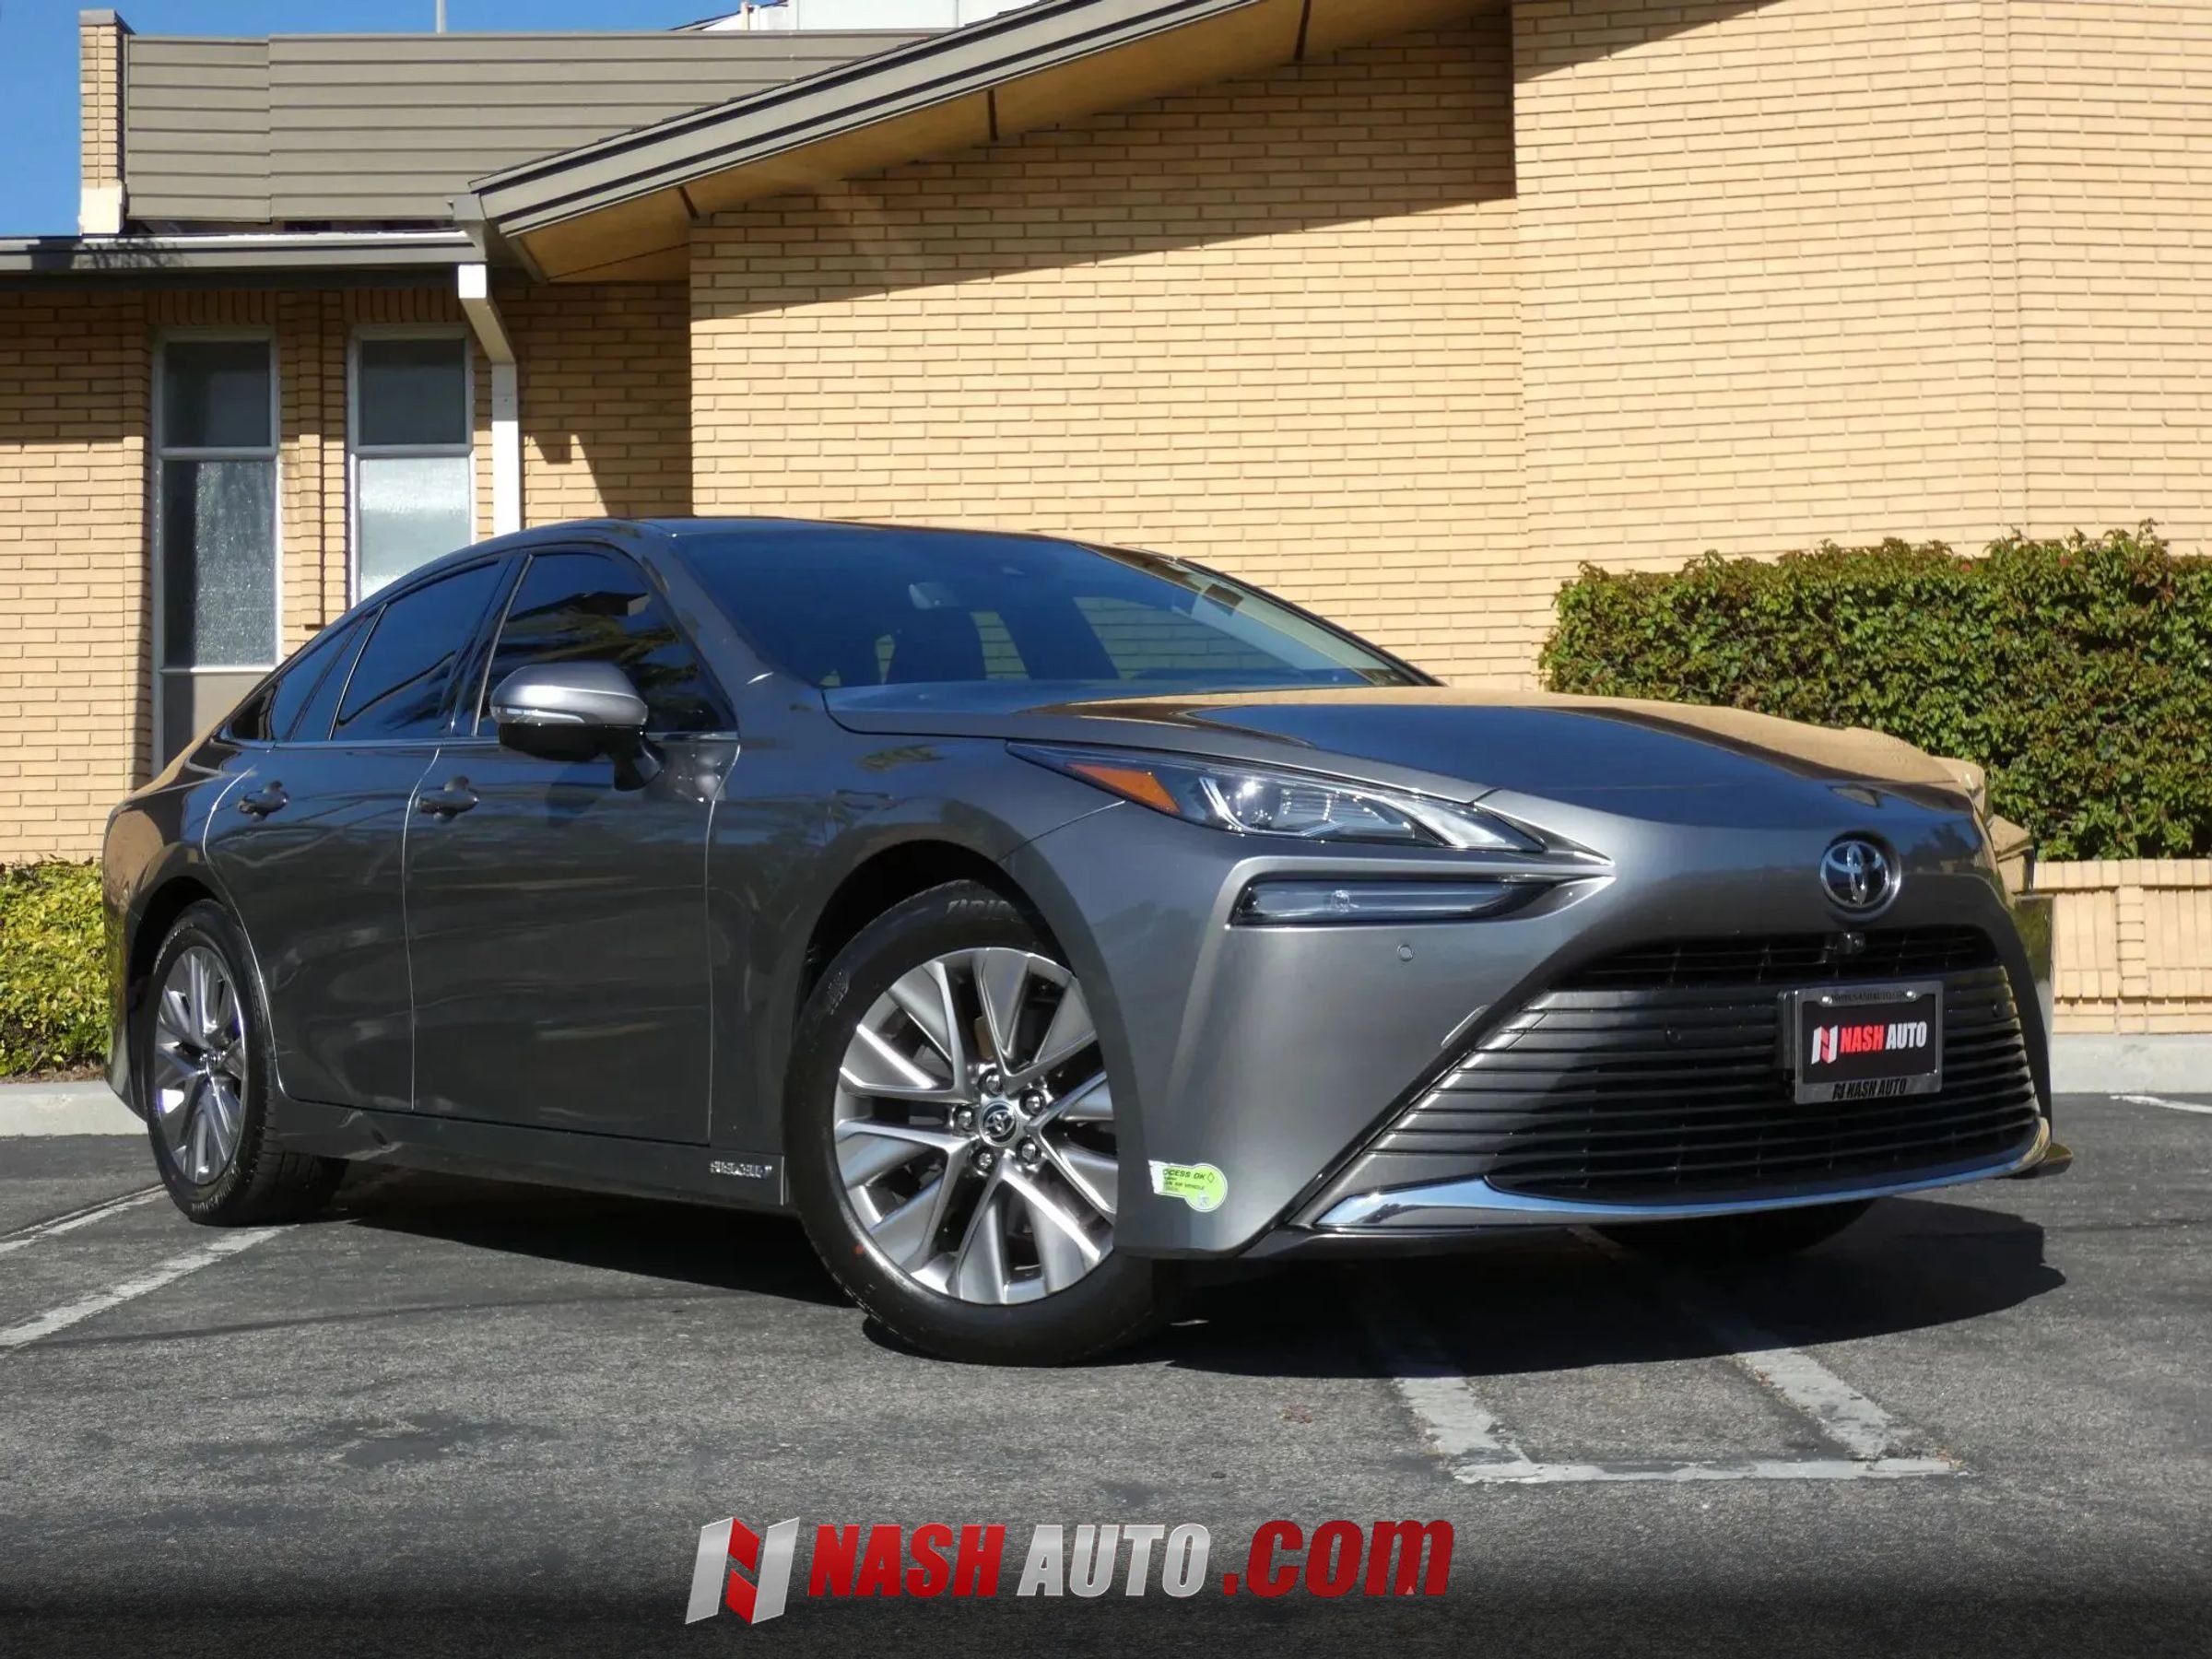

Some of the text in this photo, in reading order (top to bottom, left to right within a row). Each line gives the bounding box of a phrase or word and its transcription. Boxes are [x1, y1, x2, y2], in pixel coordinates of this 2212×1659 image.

[1840, 1025, 1886, 1053] NASH
[1885, 1021, 1927, 1050] AUTO
[1846, 1080, 1877, 1099] NASH
[1877, 1077, 1907, 1096] AUTO
